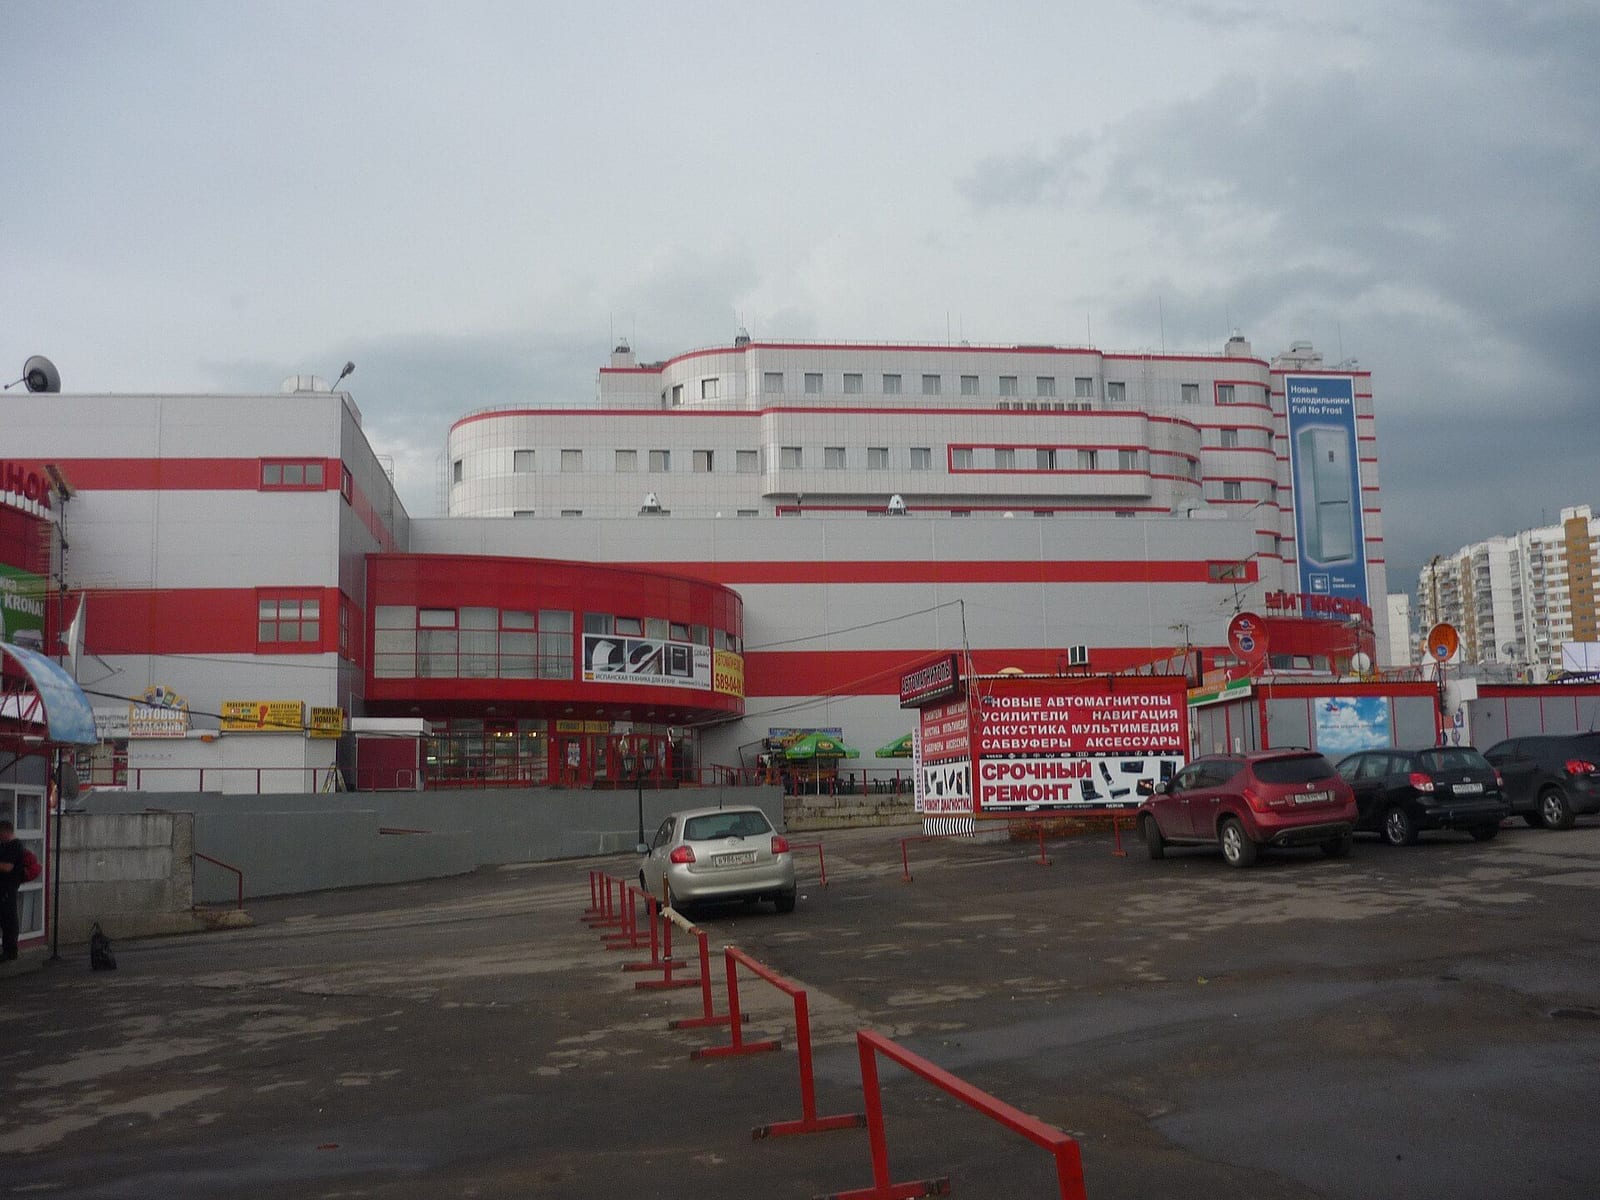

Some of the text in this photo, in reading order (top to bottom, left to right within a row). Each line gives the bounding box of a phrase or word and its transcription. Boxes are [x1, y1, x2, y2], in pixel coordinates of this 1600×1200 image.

[1290, 385, 1318, 394] Новые
[1291, 397, 1350, 405] холодильники
[1292, 405, 1343, 415] Full No Frost
[991, 695, 1171, 708] НОВЫЕ АВТОМАГНИТОЛЫ
[132, 708, 185, 720] СОТОВЫЕ
[981, 709, 1178, 722] УСИЛИТЕЛИ НАВИГАЦИЯ
[982, 722, 1179, 735] АККУСТИКА МУЛЬТИМЕДИЯ
[981, 736, 1180, 749] САБВУФЕРЫ АКСЕССУАРЫ
[981, 759, 1092, 780] СРОЧНЫЙ
[983, 783, 1072, 802] РЕМОНТ
